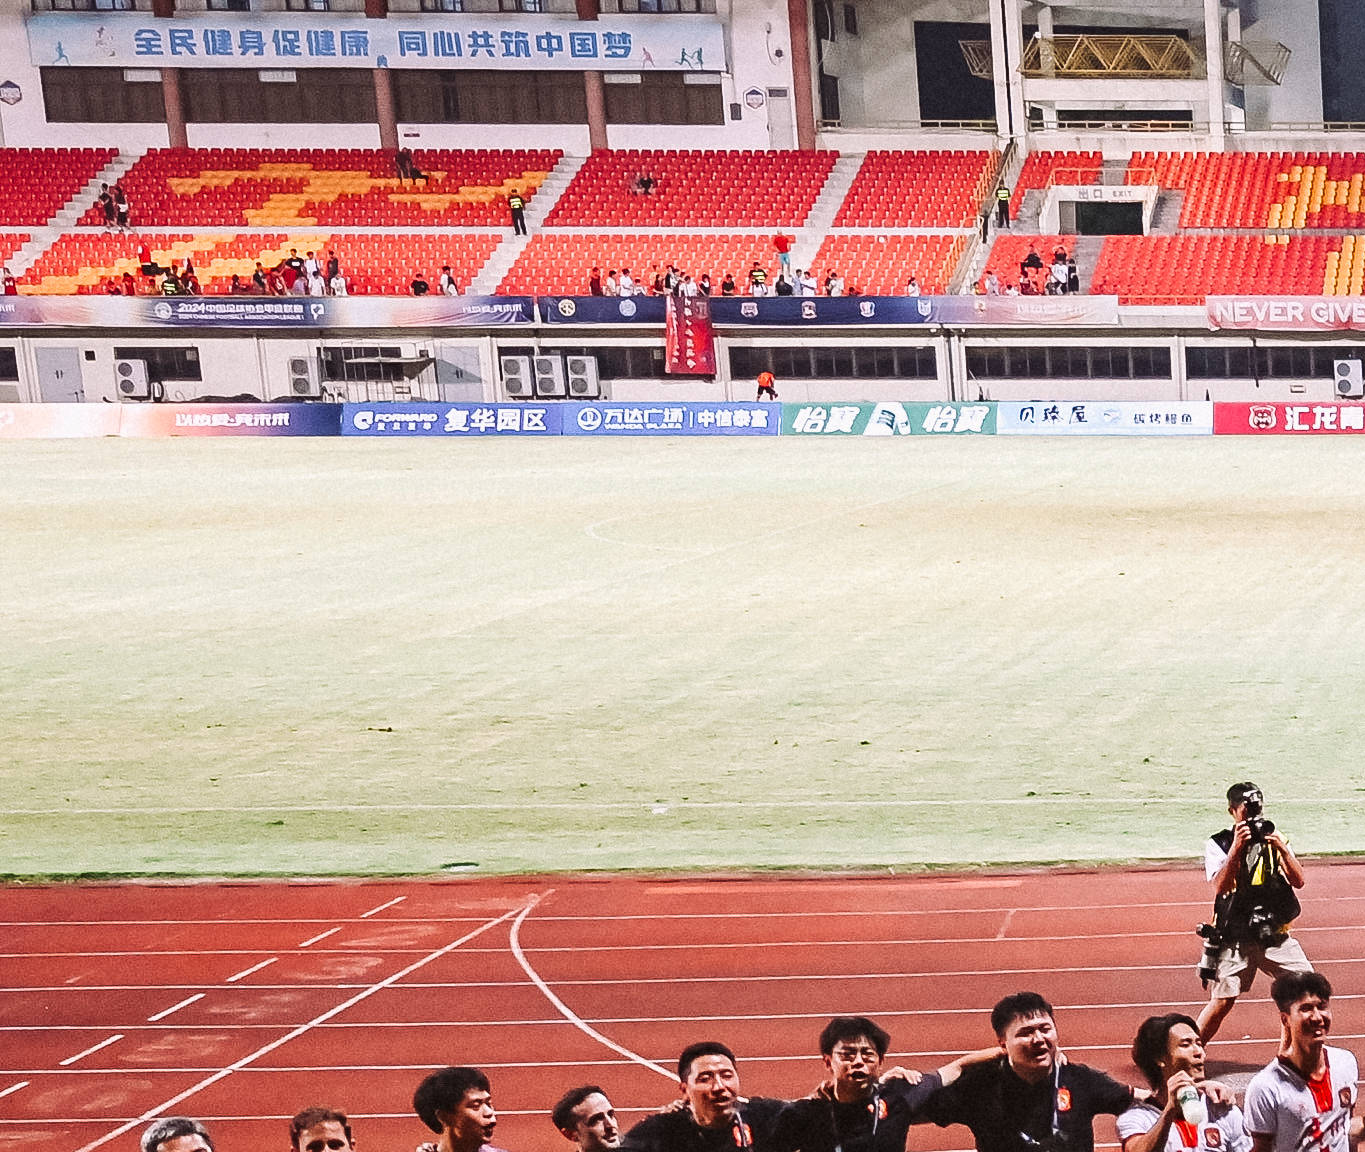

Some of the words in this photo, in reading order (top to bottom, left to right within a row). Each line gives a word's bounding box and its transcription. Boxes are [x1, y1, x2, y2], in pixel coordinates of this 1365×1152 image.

[134, 29, 370, 57] 全民健身促健康
[398, 30, 633, 59] 同心共筑中国梦
[1079, 188, 1102, 199] 出口
[1215, 300, 1304, 323] NEVER
[374, 413, 438, 422] FORWARD
[444, 408, 547, 432] 复华园区
[604, 407, 684, 424] 万达广场
[698, 409, 769, 428] 中信泰富
